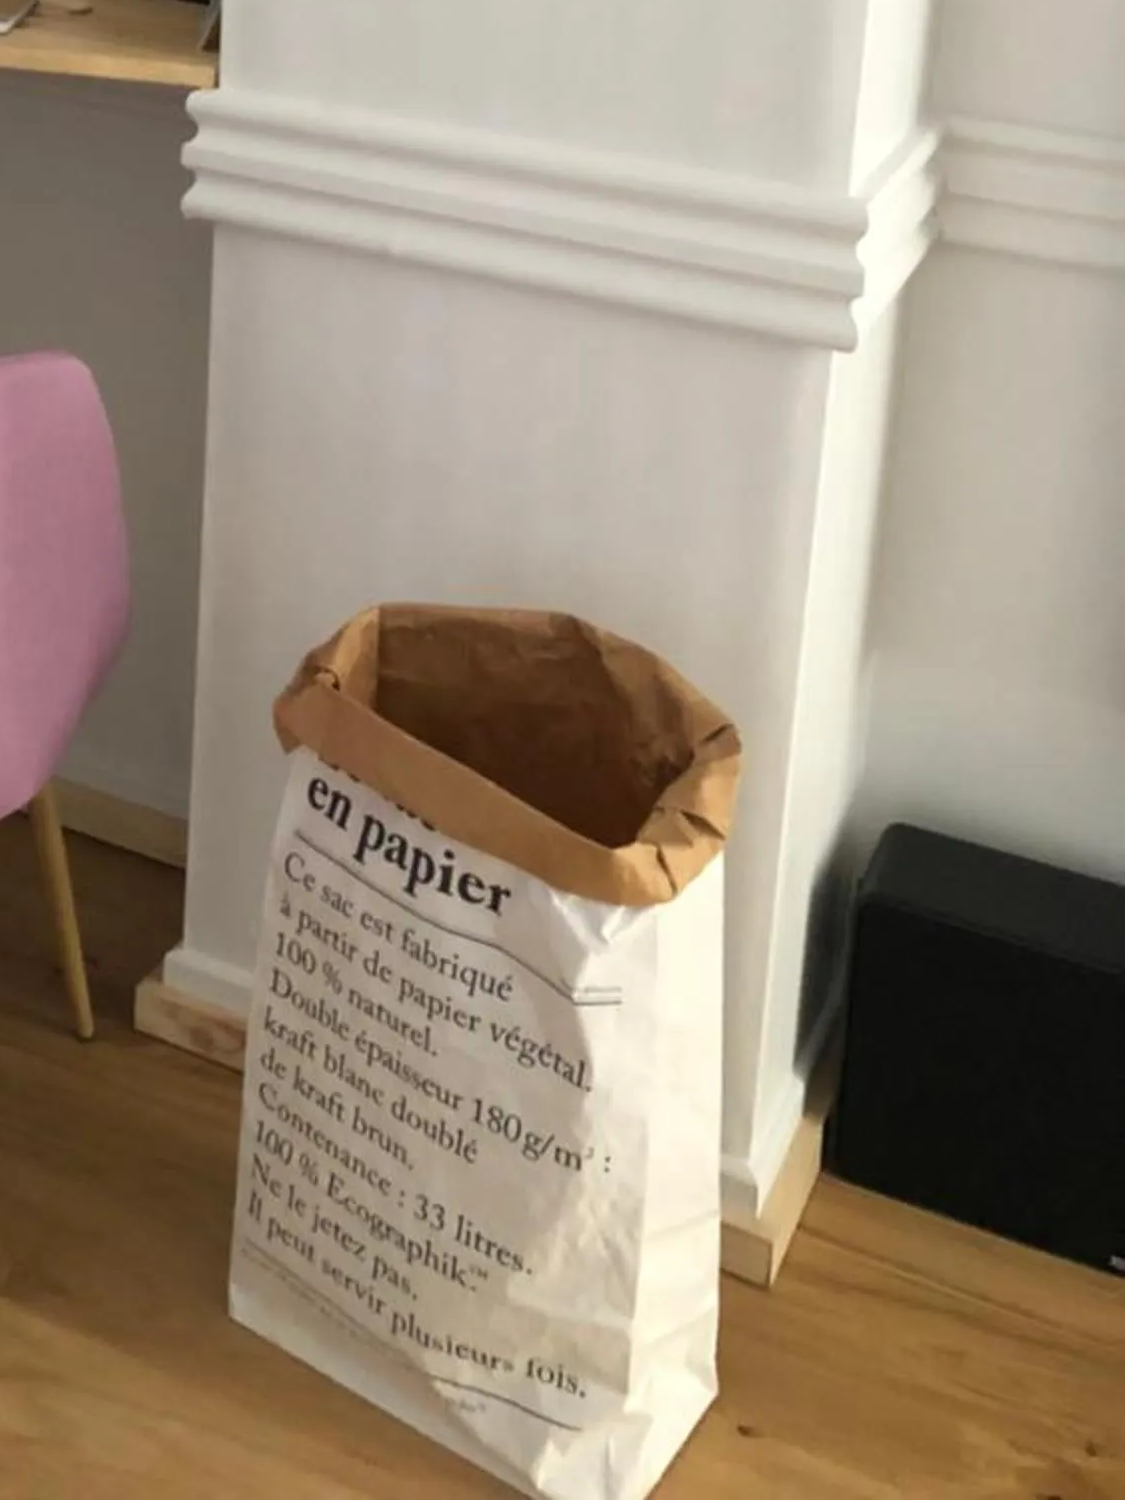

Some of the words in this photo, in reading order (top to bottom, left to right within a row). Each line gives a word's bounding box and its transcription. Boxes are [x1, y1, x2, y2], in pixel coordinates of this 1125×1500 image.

[307, 776, 353, 832] en
[353, 813, 512, 917] papier
[275, 931, 317, 975] 100
[321, 959, 344, 996] %
[347, 988, 438, 1058] naturel.
[279, 890, 292, 918] à
[296, 910, 359, 964] partir
[362, 950, 393, 984] de
[397, 976, 483, 1033] papier
[489, 1020, 592, 1093] végétal.
[284, 851, 316, 892] Ce
[320, 884, 355, 919] sac
[360, 911, 394, 944] est
[400, 928, 514, 1003] fabriqué
[259, 1047, 288, 1080] de
[292, 1065, 345, 1124] kraft
[351, 1105, 415, 1172] brun.
[263, 1005, 318, 1061] kraft
[323, 1043, 385, 1107] blanc
[390, 1094, 478, 1165] doublé
[269, 967, 350, 1042] Double
[354, 1029, 465, 1111] épaisseur
[251, 1152, 282, 1199] Ne
[287, 1184, 307, 1218] le
[310, 1204, 367, 1264] jetez
[371, 1255, 418, 1301] pas.
[256, 1119, 294, 1167] 100
[298, 1151, 320, 1188] %
[258, 1081, 393, 1198] Contenance
[413, 1194, 446, 1232] 33
[455, 1213, 534, 1277] litres.
[248, 1188, 263, 1222] Il
[266, 1216, 315, 1264] peut
[321, 1258, 388, 1315] servir
[391, 1311, 516, 1373] plusieurs
[525, 1356, 587, 1399] fois.
